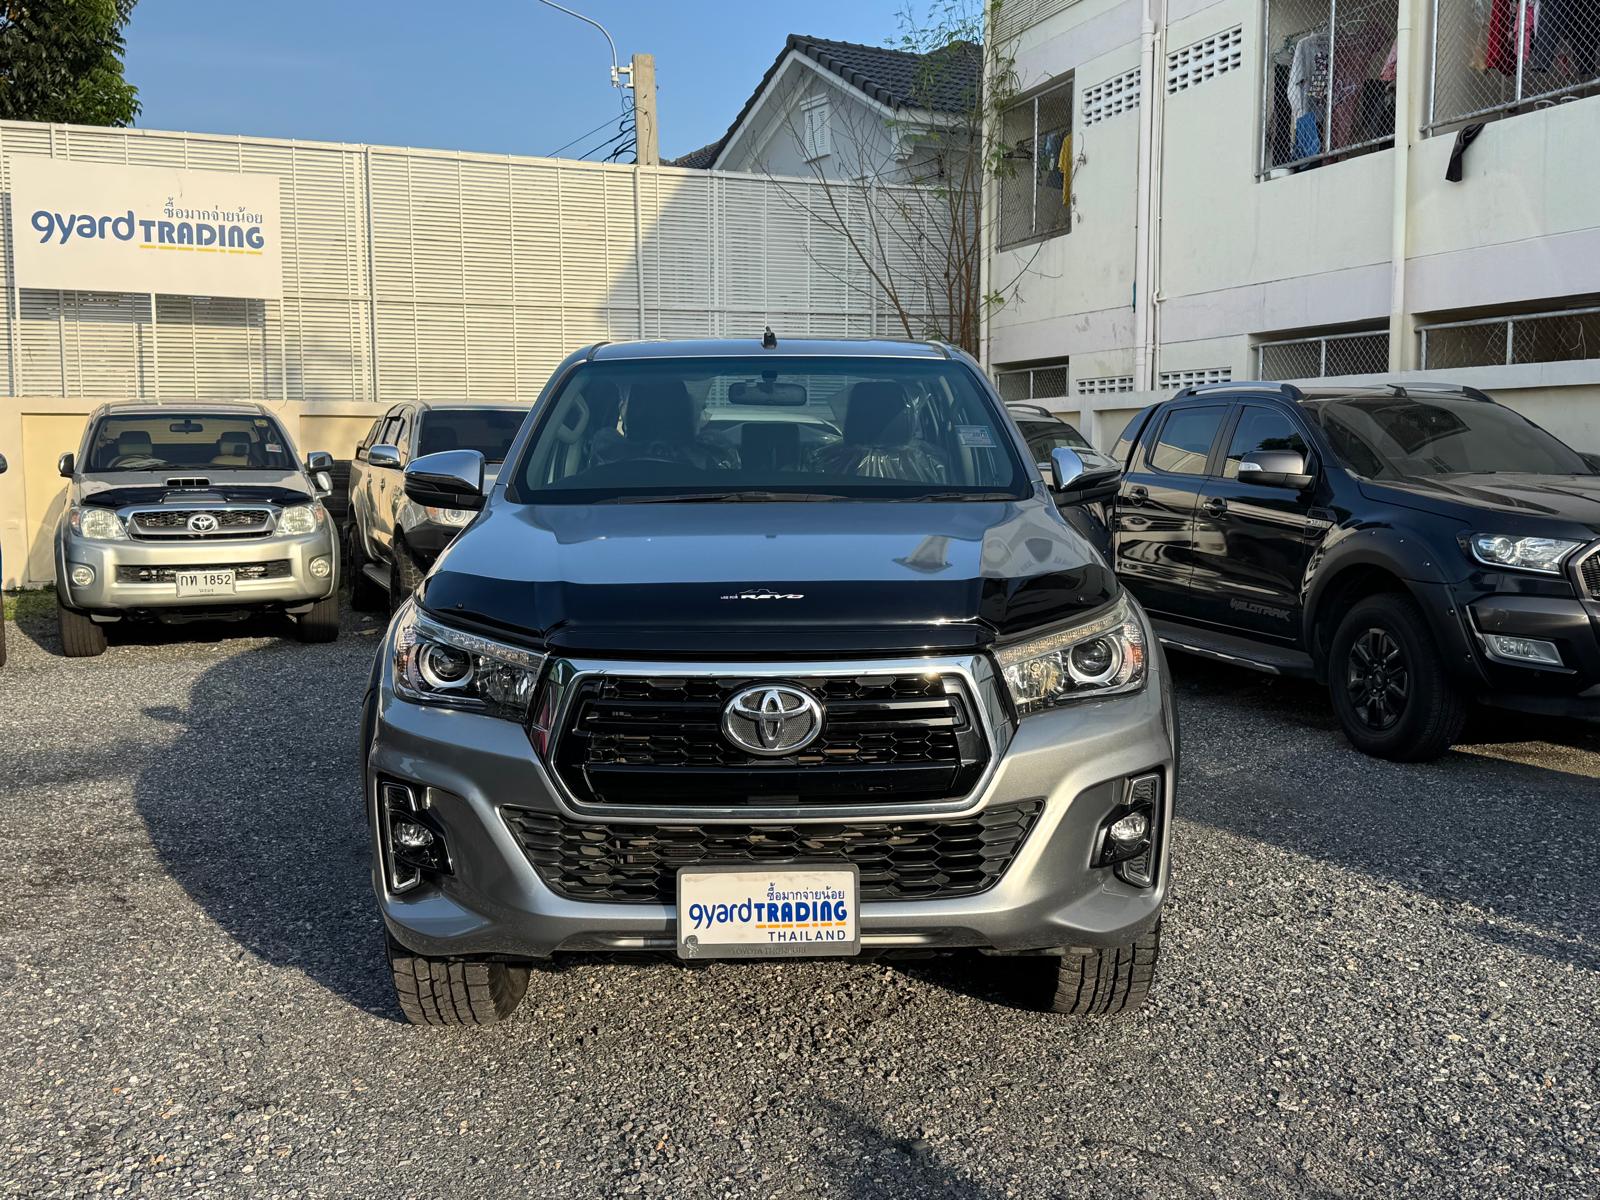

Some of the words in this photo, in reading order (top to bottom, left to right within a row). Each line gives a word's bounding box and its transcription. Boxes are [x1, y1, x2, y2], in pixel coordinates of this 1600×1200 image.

[163, 197, 263, 224] ซื้อมากจ่ายน้อย
[31, 210, 135, 245] 9yard
[139, 219, 265, 249] TRADING
[203, 574, 231, 586] 1852
[767, 882, 845, 901] ซื้อมากจ่ายน้อย
[689, 897, 752, 930] 9yard
[754, 900, 848, 922] TRADING
[768, 930, 846, 942] THAILAND
